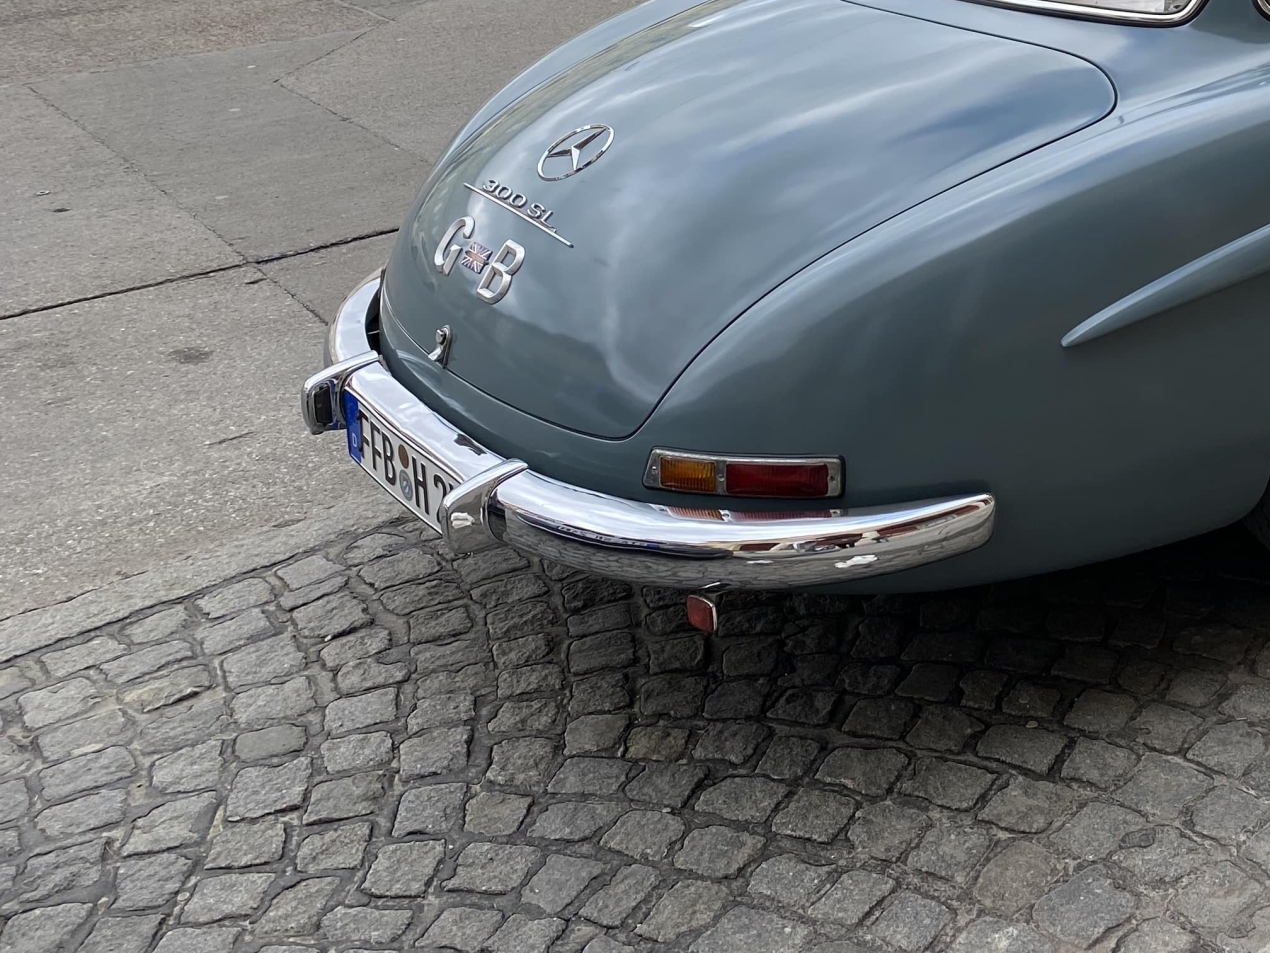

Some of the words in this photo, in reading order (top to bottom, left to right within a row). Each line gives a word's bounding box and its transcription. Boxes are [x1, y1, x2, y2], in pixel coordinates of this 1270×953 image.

[482, 179, 528, 209] 300
[526, 202, 557, 233] SL
[357, 409, 396, 486] FFB
[411, 455, 430, 516] H
